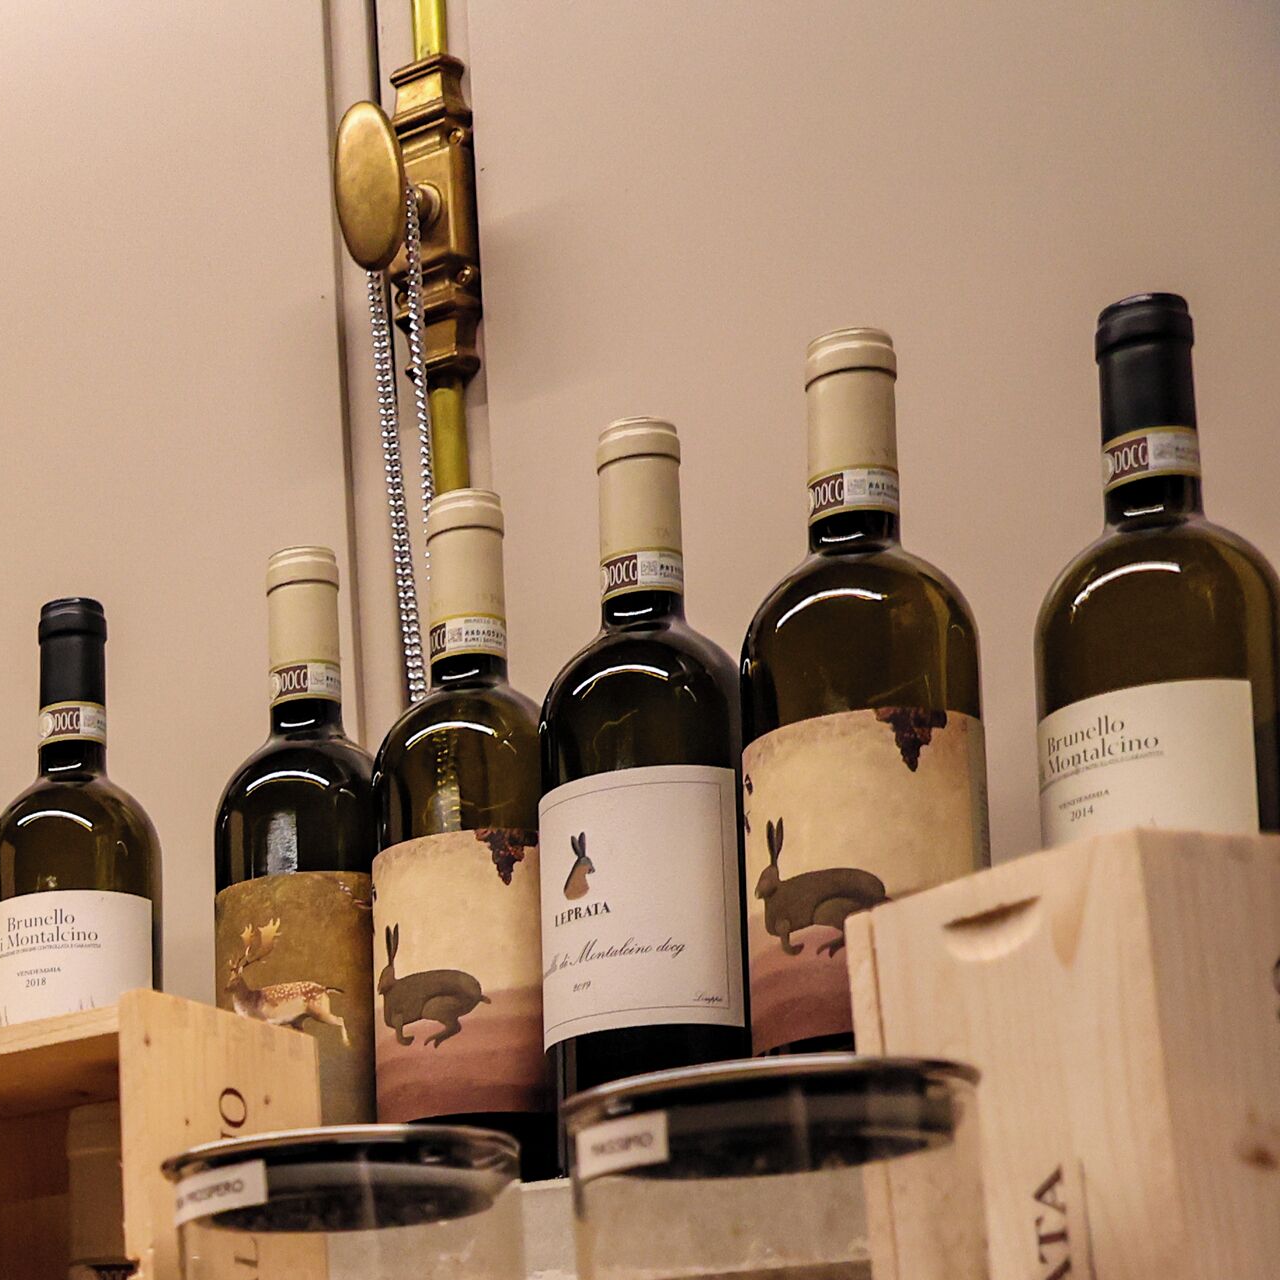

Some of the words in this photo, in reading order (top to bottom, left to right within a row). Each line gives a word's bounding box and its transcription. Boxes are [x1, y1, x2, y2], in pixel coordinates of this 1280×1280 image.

[1047, 715, 1125, 757] Brunello
[1048, 736, 1159, 775] Montalcino
[1070, 804, 1094, 822] 2014
[7, 908, 76, 932] Brunello
[7, 926, 99, 950] Montalcino
[25, 977, 47, 988] 2018
